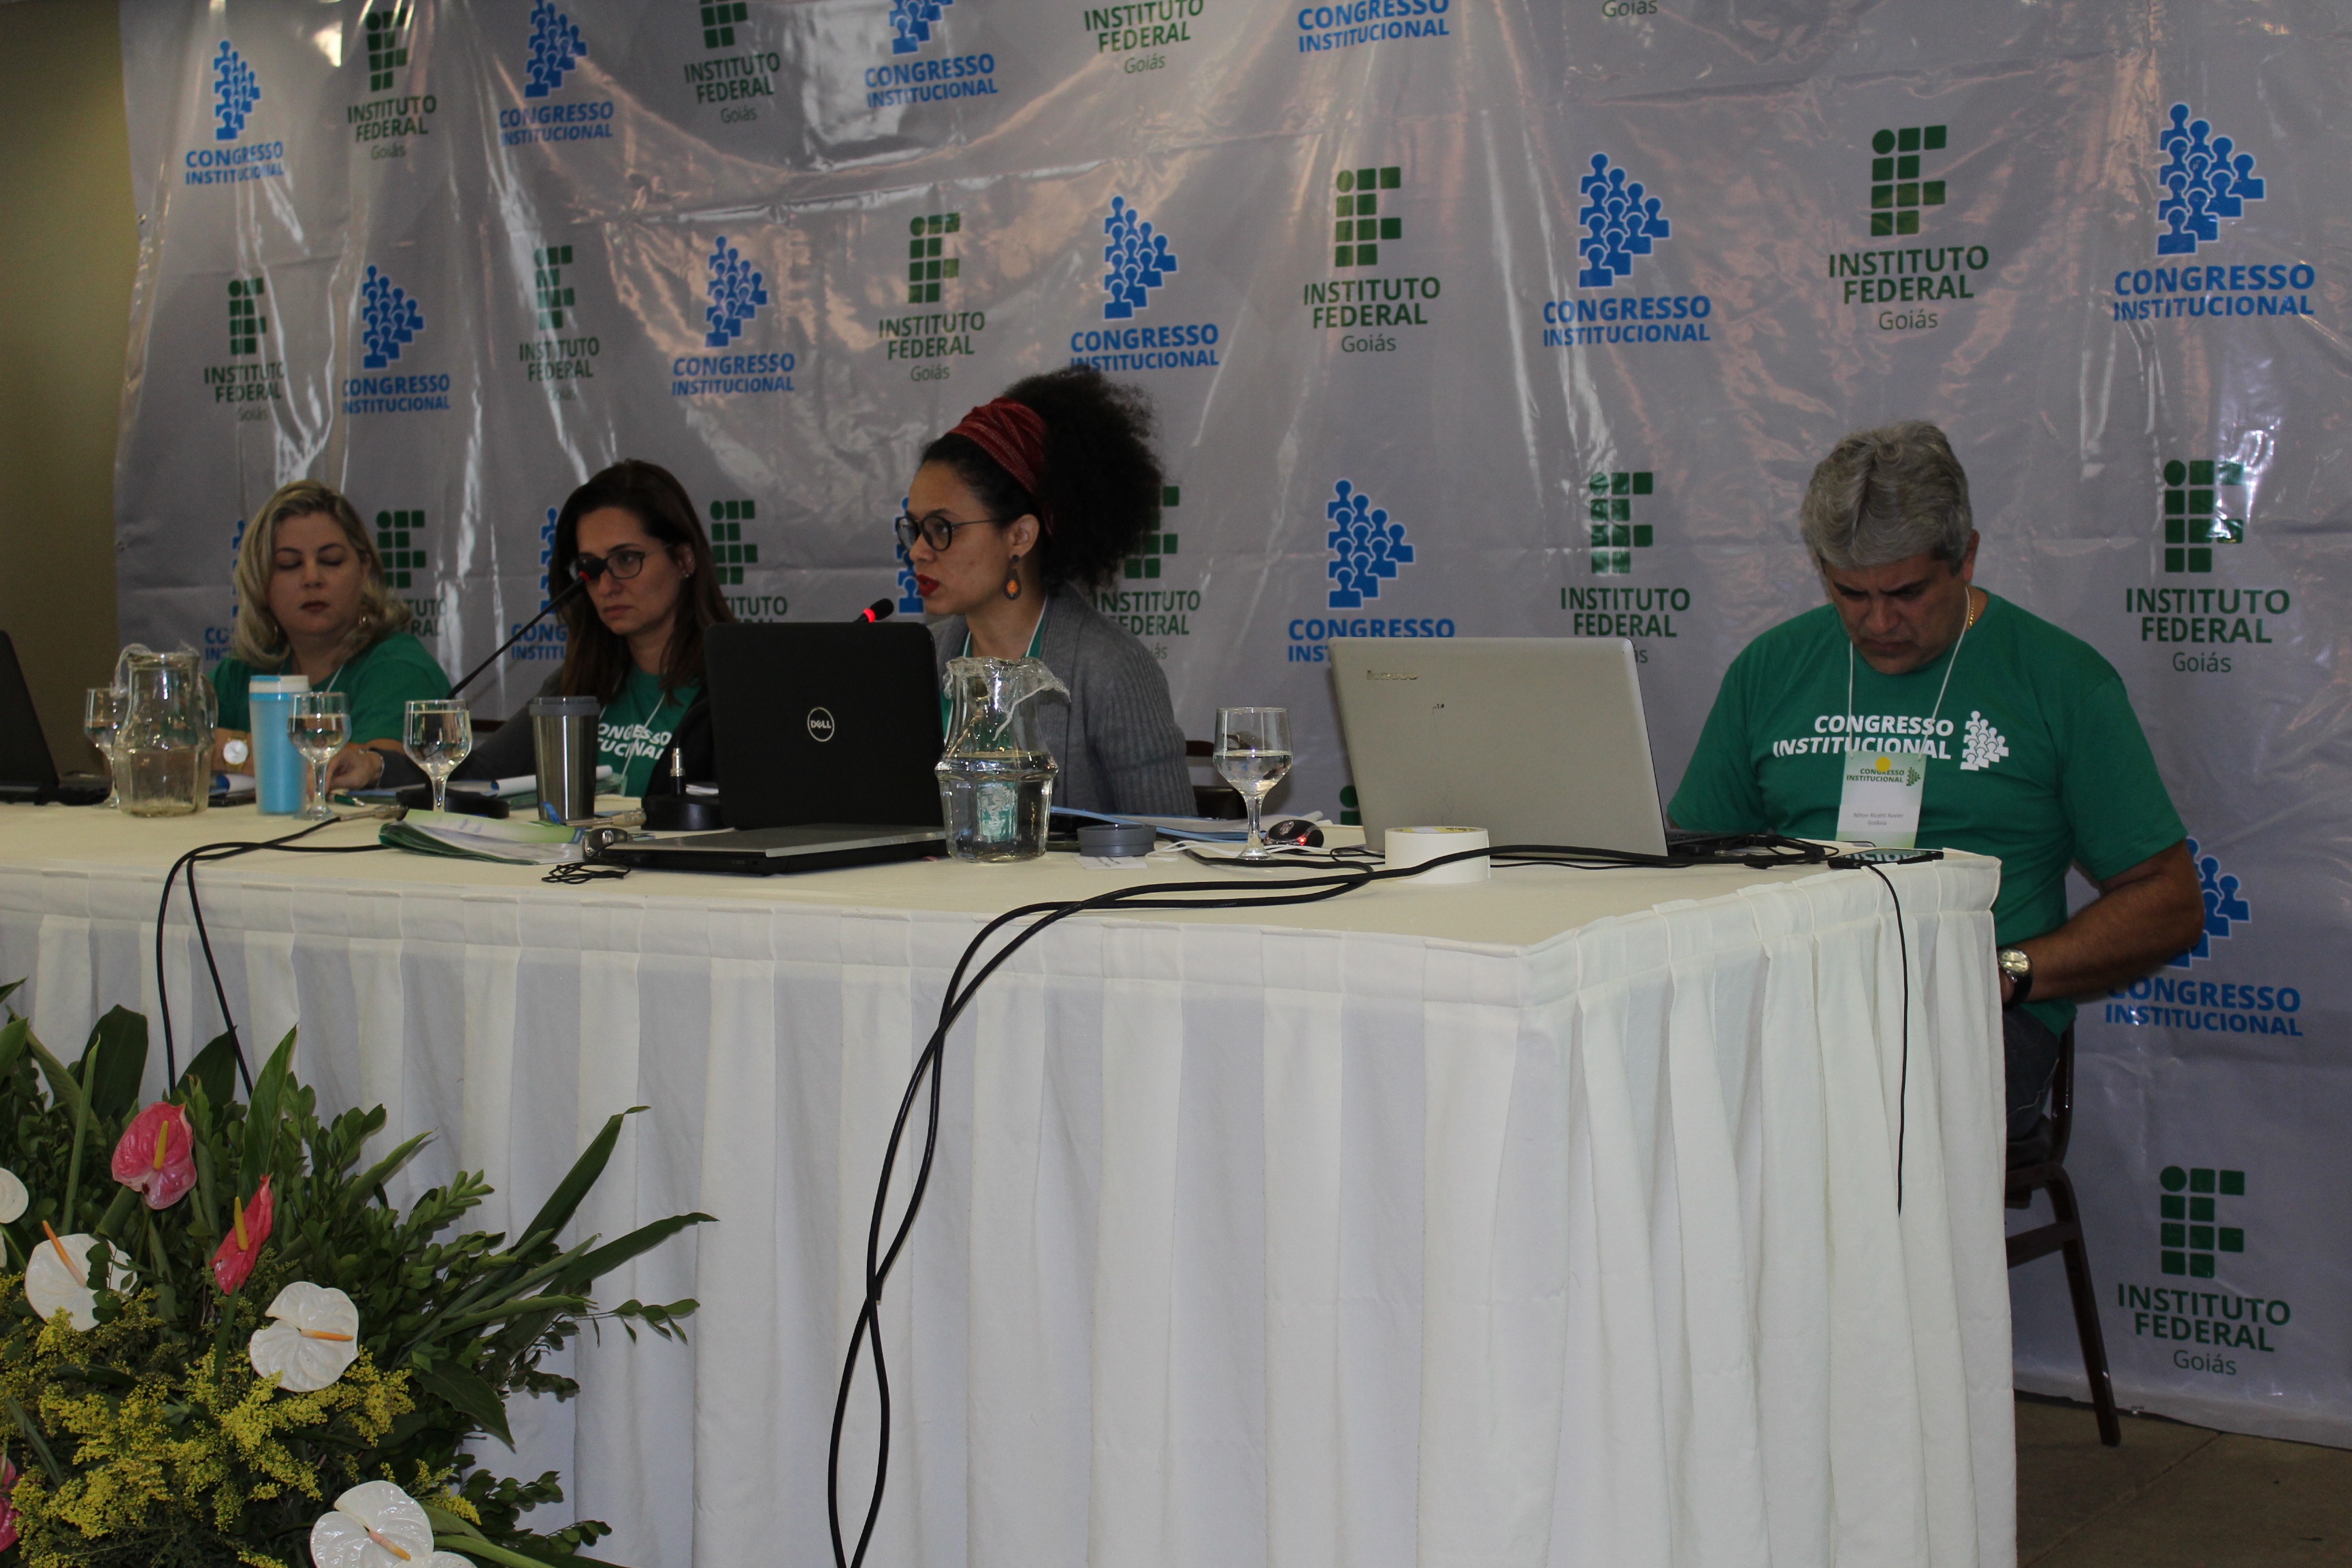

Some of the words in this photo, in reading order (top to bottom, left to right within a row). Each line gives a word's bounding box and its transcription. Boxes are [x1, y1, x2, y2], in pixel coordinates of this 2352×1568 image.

[1084, 0, 1203, 31] INSTITUTO
[1298, 0, 1450, 31] CONGRESSO
[1098, 20, 1191, 54] FEDERAL
[1298, 18, 1450, 52] INSTITUCIONAL
[684, 52, 780, 84] INSTITUTO
[865, 53, 995, 88] CONGRESSO
[1124, 52, 1166, 74] Goiás
[696, 75, 775, 104] FEDERAL
[866, 78, 999, 108] INSTITUCIONAL
[347, 94, 437, 124] INSTITUTO
[500, 101, 613, 129] CONGRESSO
[720, 105, 757, 123] Goiás
[355, 116, 429, 142] FEDERAL
[186, 141, 283, 167] CONGRESSO
[1829, 246, 1989, 278] INSTITUTO
[1304, 277, 1441, 305] INSTITUTO
[1844, 274, 1974, 304] FEDERAL
[2114, 264, 2315, 296] CONGRESSO
[1313, 303, 1428, 329] FEDERAL
[1544, 295, 1712, 324] CONGRESSO
[1879, 308, 1938, 330] Goiás
[2113, 295, 2314, 321] INSTITUCIONAL
[879, 311, 985, 338] INSTITUTO
[1544, 323, 1711, 347] INSTITUCIONAL
[519, 337, 600, 361] INSTTUTO
[887, 336, 975, 360] FEDERAL
[1071, 323, 1219, 353] CONGRESSO
[1341, 333, 1396, 353] Goiás
[528, 359, 593, 381] FEDERAL
[672, 353, 795, 376] CONGRESSO
[911, 363, 950, 381] Goiás
[215, 382, 281, 403] FEDERAL
[342, 374, 450, 397] CONGRESSO
[671, 376, 795, 396] INSTITUCIONAL
[723, 596, 787, 615] ITUTO
[1092, 590, 1201, 612] INSTITUTO
[1561, 587, 1691, 611] INSTITUTO
[2127, 588, 2291, 614] INSTITUTO
[1111, 615, 1190, 636] EDERAL
[1289, 619, 1455, 640] CONGRESSO
[1574, 613, 1678, 638] FEDERAL
[2142, 617, 2272, 643] FEDERAL
[2173, 652, 2232, 673] Goiás
[811, 720, 832, 729] DELL
[1814, 715, 1955, 737] CONGRESSO
[1773, 737, 1952, 760] INSTITUCIONAL
[1846, 774, 1904, 783] INSTITUCIONAL
[2106, 1004, 2304, 1037] INSTITUCIONAL
[2119, 1284, 2291, 1326] INSTITUTO
[2135, 1312, 2274, 1352] FEDERAL
[2174, 1350, 2237, 1375] Goiás
